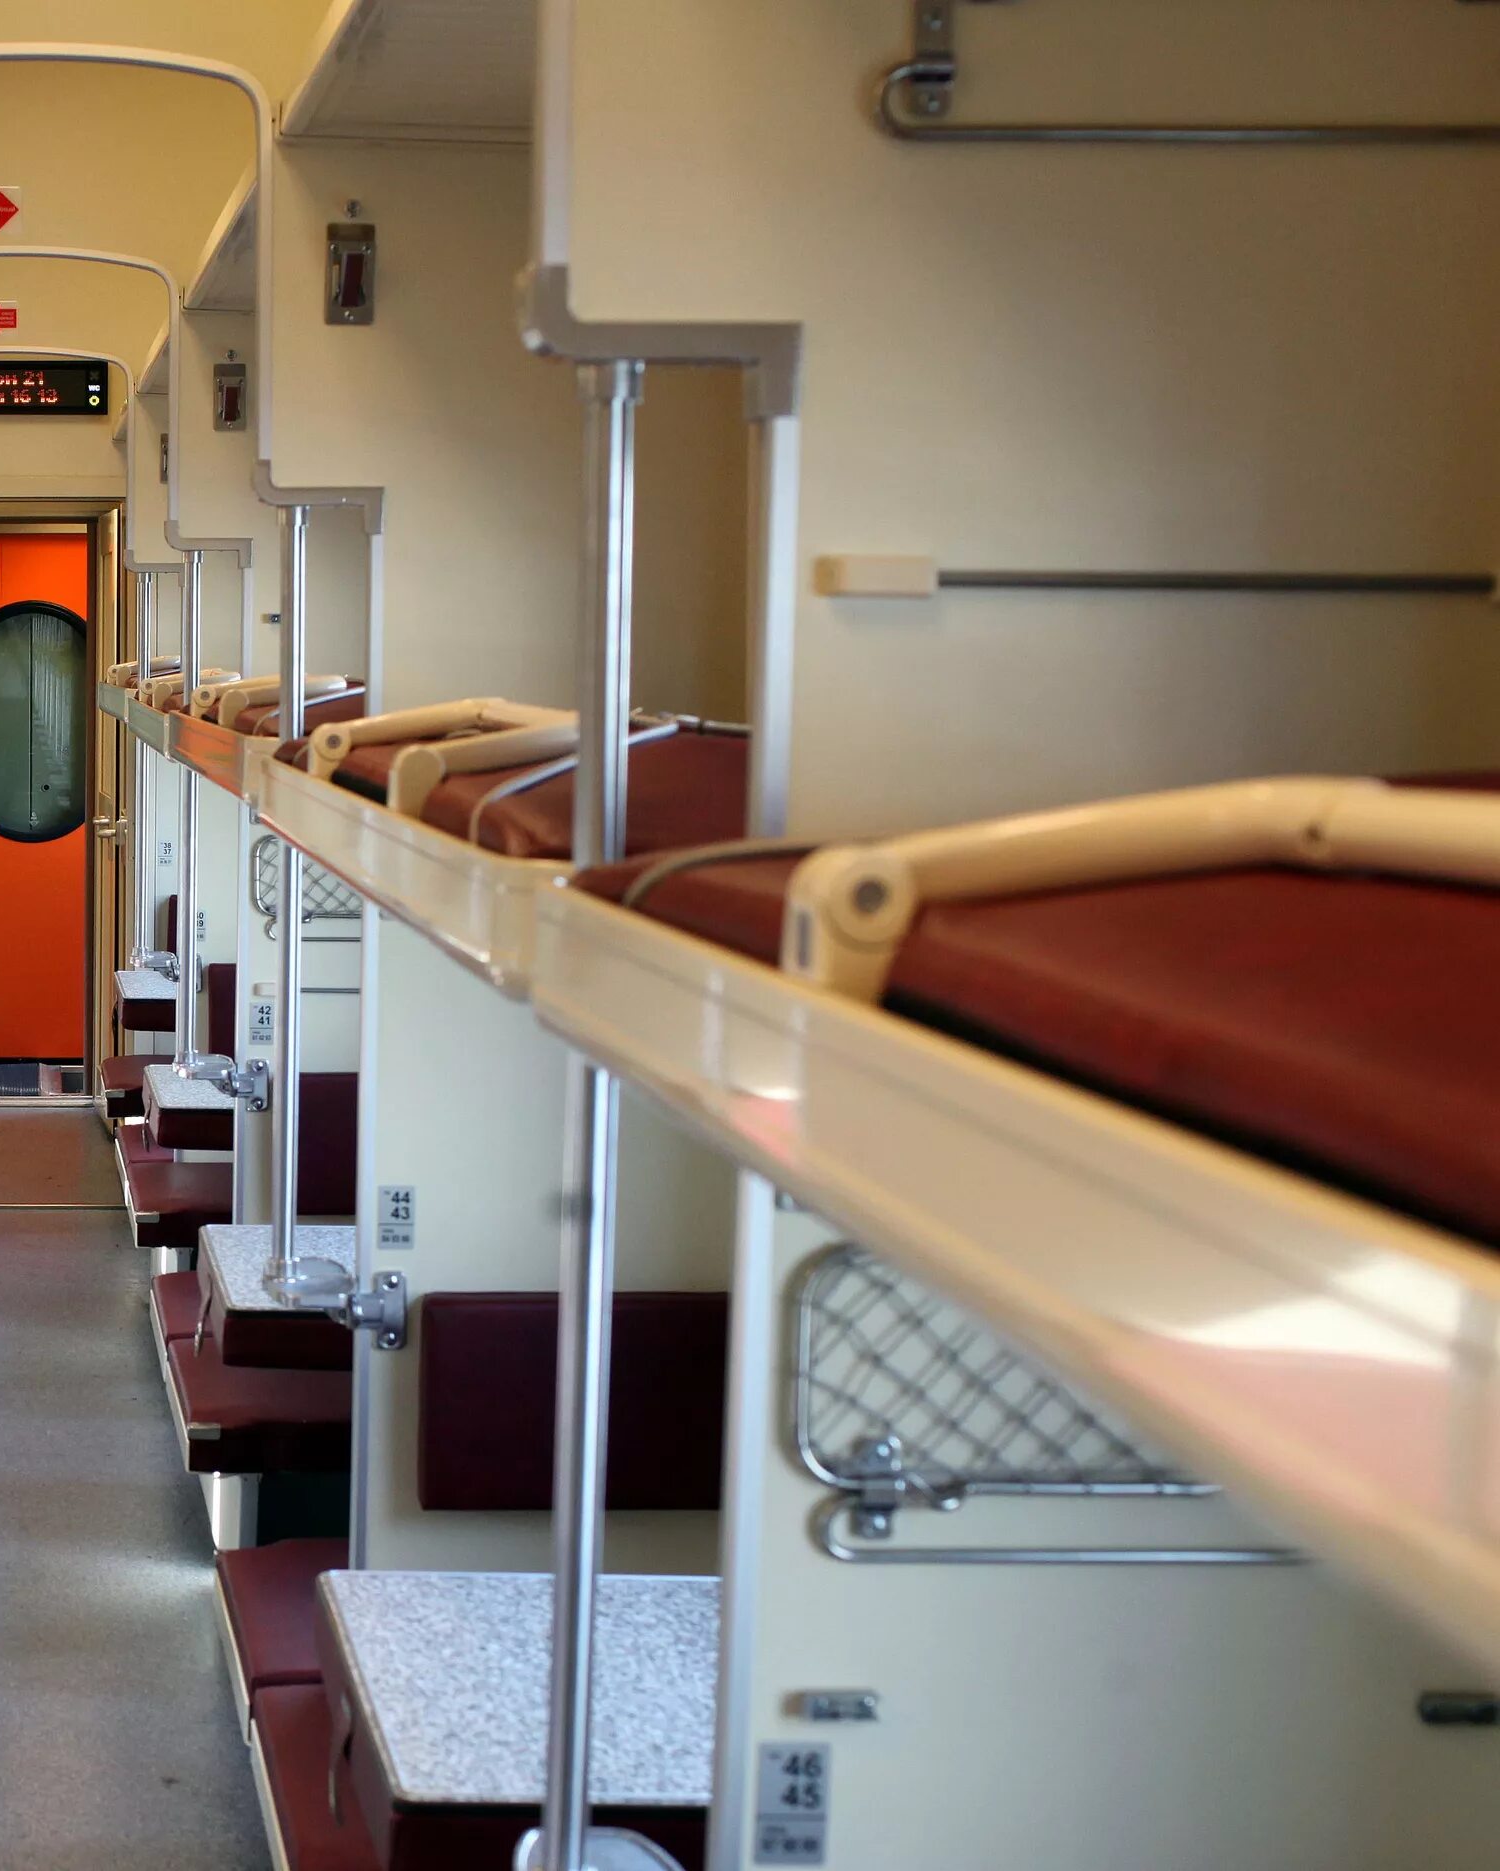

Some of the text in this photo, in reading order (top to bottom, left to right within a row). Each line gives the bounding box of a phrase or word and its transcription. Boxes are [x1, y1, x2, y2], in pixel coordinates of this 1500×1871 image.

[23, 370, 44, 385] 21
[258, 1006, 271, 1015] 42
[258, 1016, 270, 1025] 41
[391, 1191, 410, 1203] 44
[391, 1206, 410, 1220] 43
[782, 1750, 822, 1779] 46
[781, 1782, 822, 1810] 45
